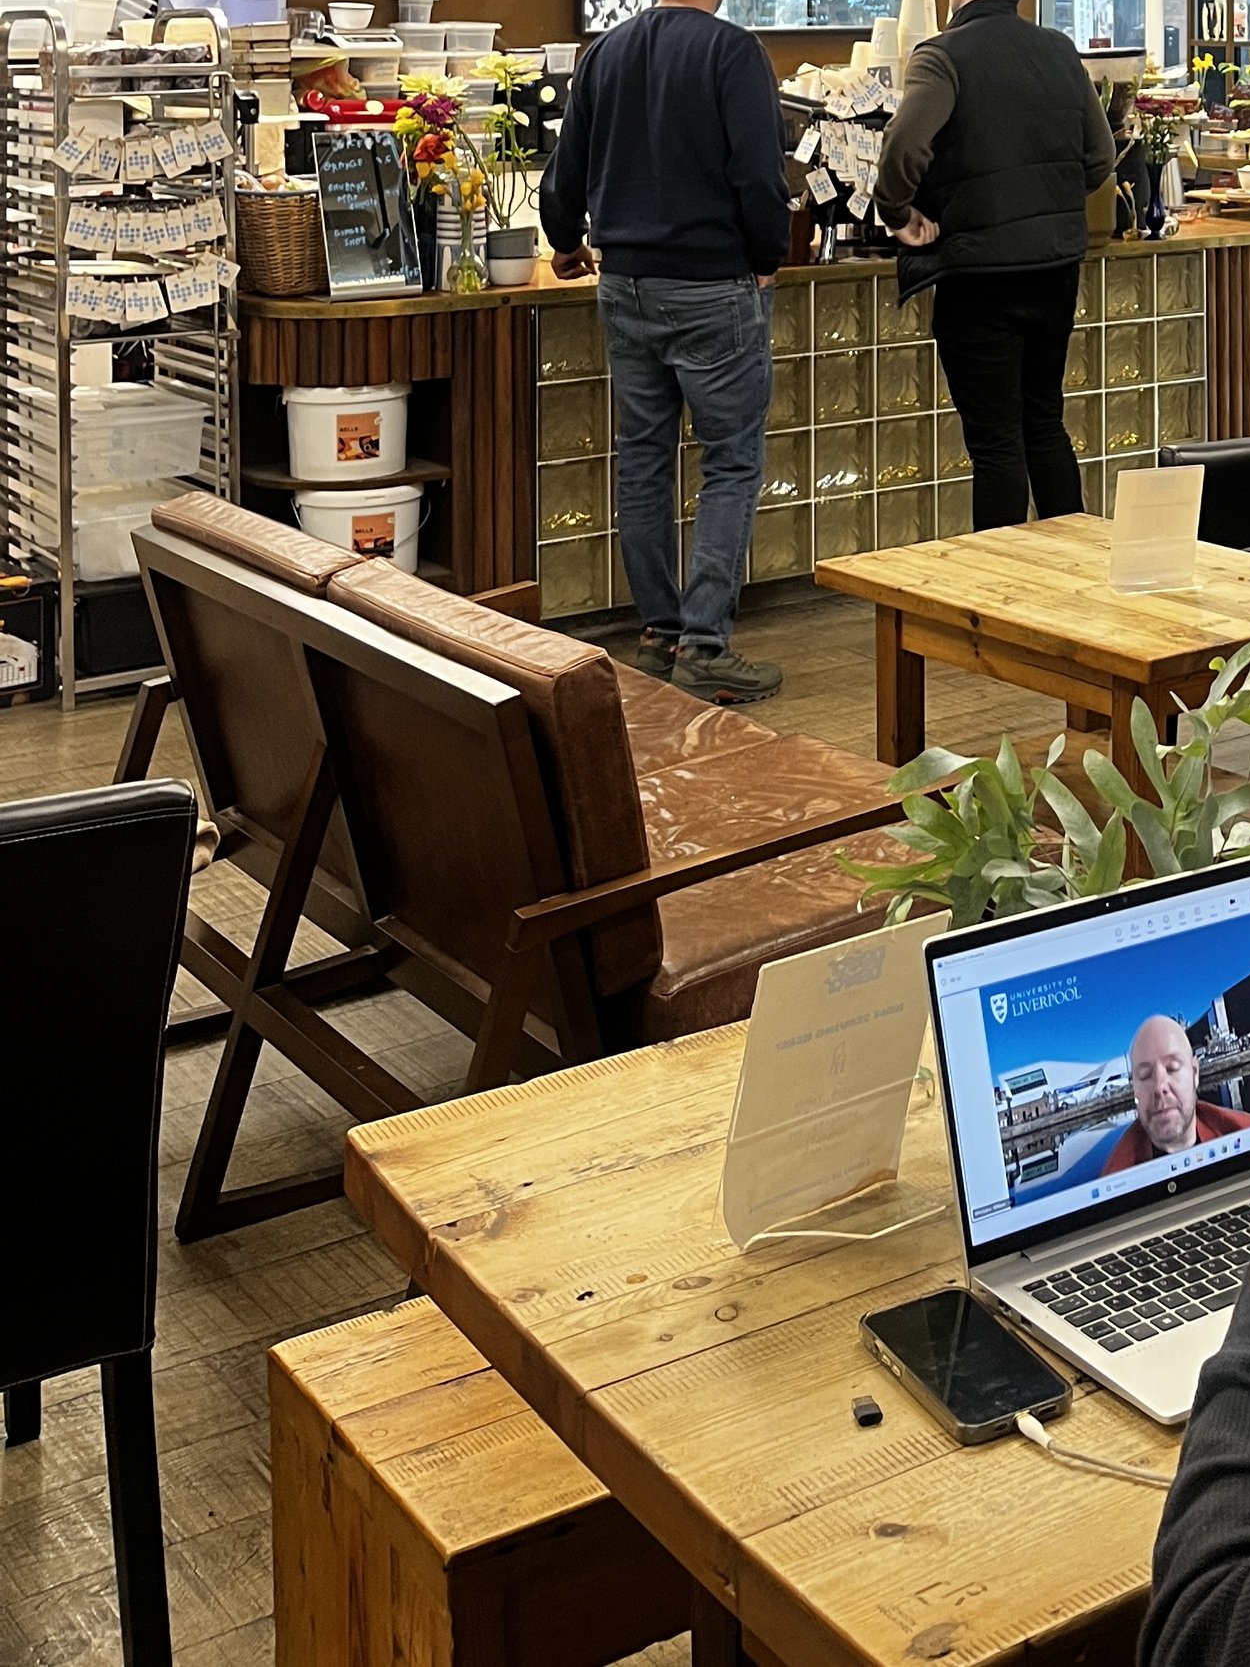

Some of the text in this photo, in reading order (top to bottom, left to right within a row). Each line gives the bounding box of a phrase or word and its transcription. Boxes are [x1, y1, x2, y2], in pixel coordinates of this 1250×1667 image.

[1009, 975, 1078, 1001] UNIVERSITY OF
[1011, 986, 1083, 1017] LIVERPOOL
